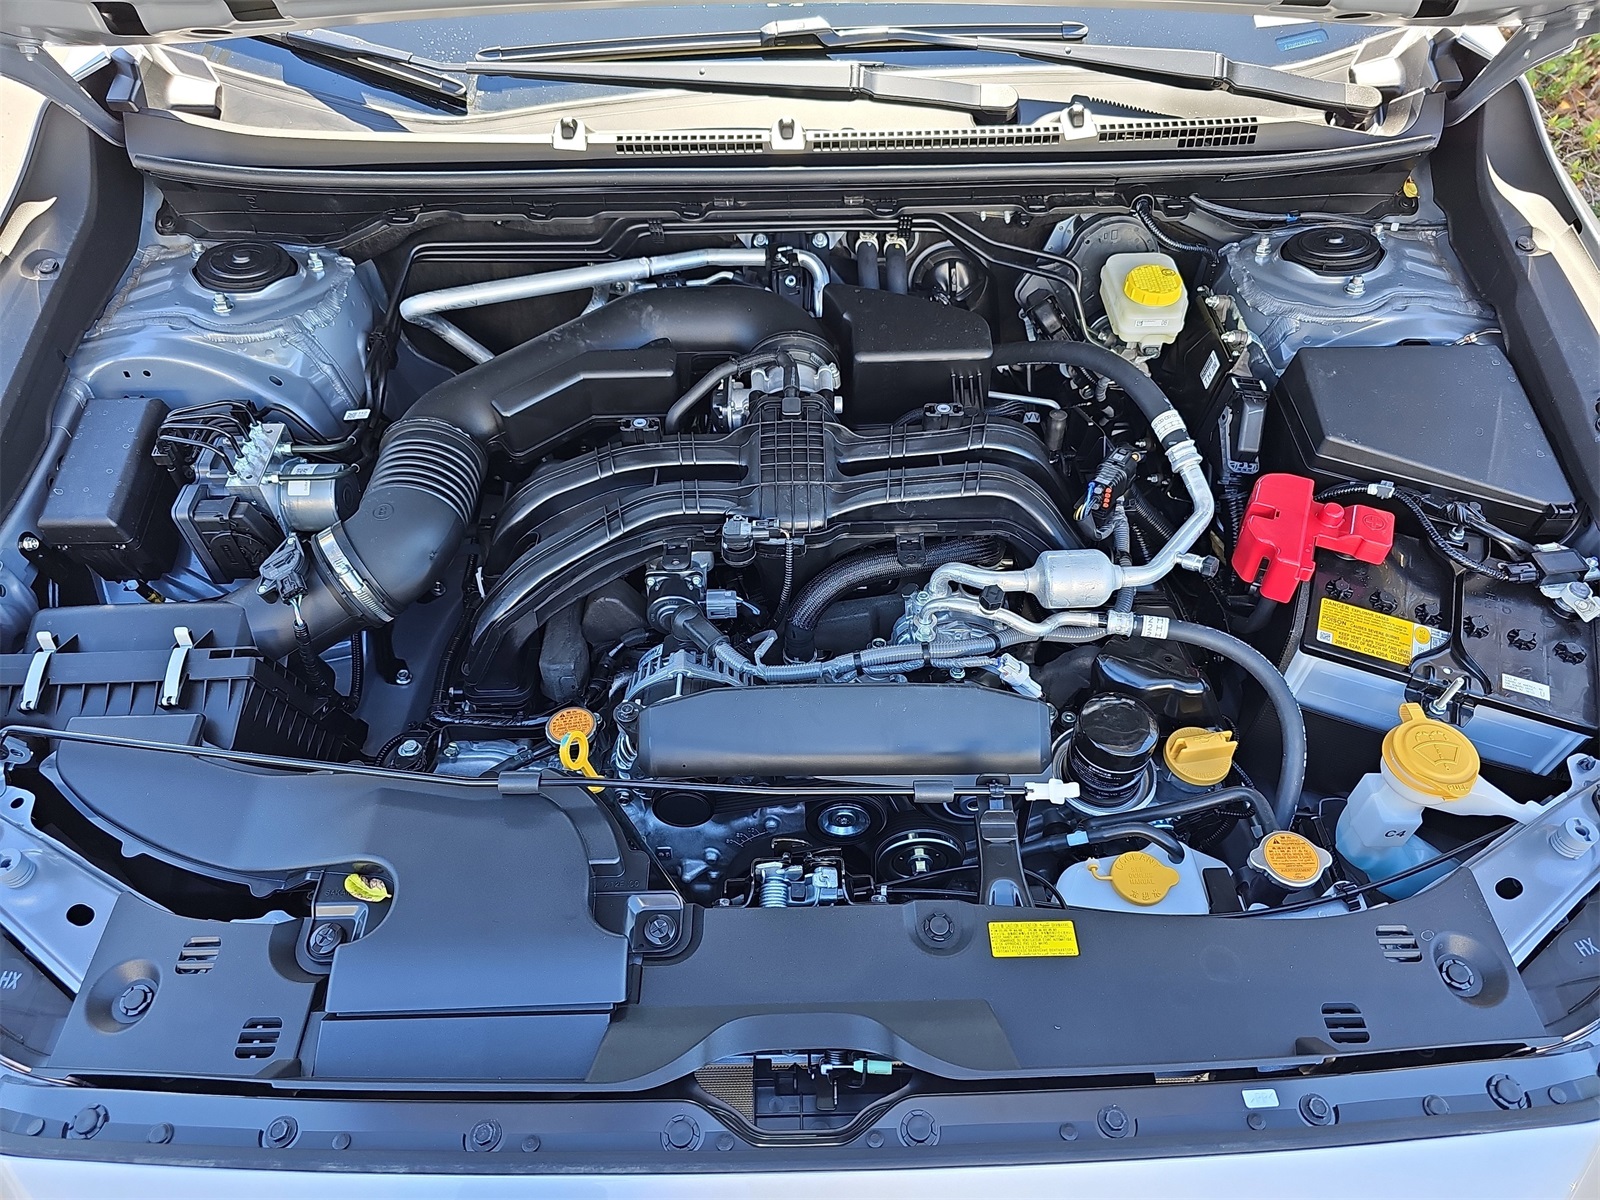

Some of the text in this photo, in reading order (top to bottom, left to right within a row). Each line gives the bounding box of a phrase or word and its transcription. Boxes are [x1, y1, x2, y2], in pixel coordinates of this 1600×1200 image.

[1323, 599, 1350, 611] DANGER
[1351, 607, 1373, 617] EXPLOSIVE
[1321, 614, 1347, 626] POISON
[1349, 623, 1367, 631] CAUSES
[1384, 830, 1407, 838] C4
[1115, 853, 1161, 871] COOLANT
[1573, 937, 1600, 957] HX
[0, 970, 23, 990] HX
